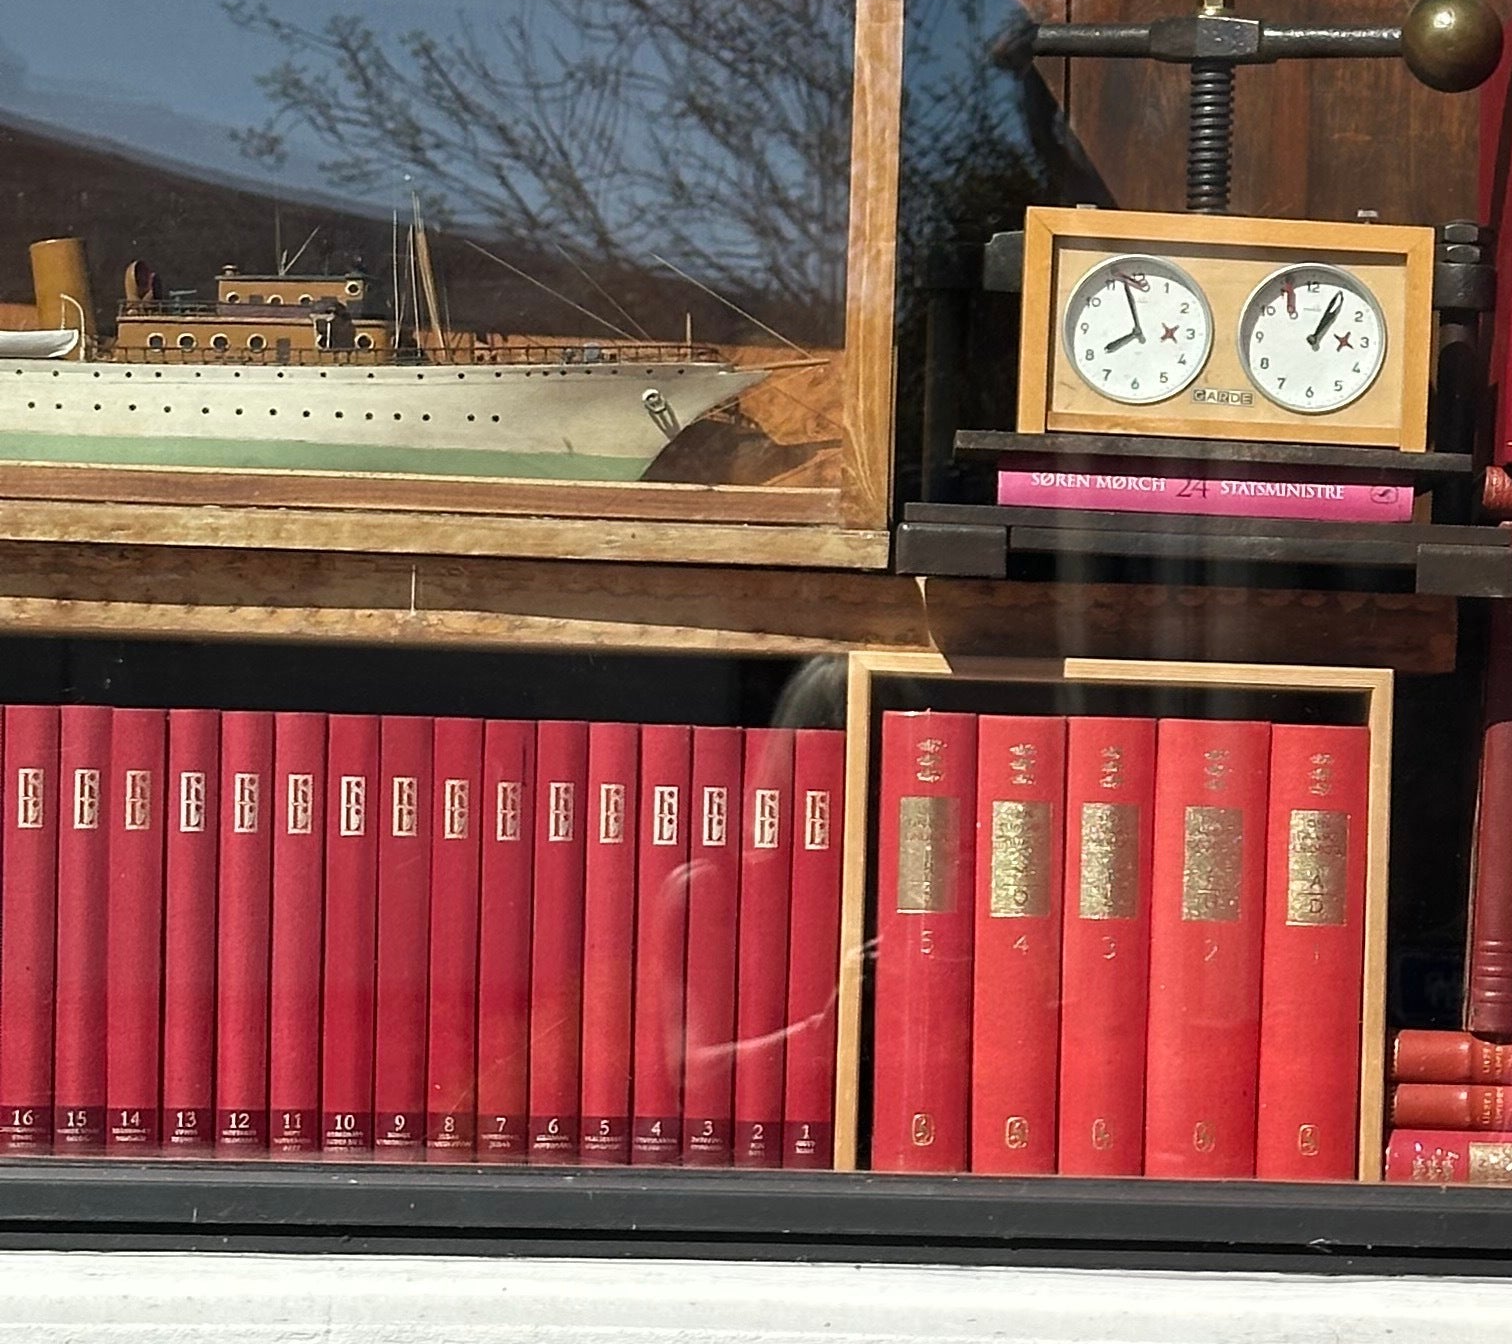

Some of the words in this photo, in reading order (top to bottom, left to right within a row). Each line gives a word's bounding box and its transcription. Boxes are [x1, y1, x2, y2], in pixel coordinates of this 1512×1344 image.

[1105, 279, 1116, 291] 11
[1163, 282, 1170, 294] 1
[1306, 280, 1320, 293] 12
[1086, 296, 1101, 308] 10
[1180, 302, 1190, 314] 2
[1261, 305, 1276, 317] 10
[1354, 311, 1364, 323] 2
[1080, 322, 1090, 335] 9
[1185, 328, 1196, 340] 3
[1255, 331, 1265, 343] 9
[1359, 337, 1370, 349] 3
[1085, 349, 1095, 361] 8
[1177, 353, 1187, 366] 4
[1260, 357, 1270, 370] 8
[1351, 362, 1361, 374] 4
[1102, 369, 1112, 382] 7
[1159, 372, 1169, 384] 5
[1130, 377, 1140, 390] 6
[1277, 377, 1287, 390] 7
[1334, 380, 1344, 392] 5
[1192, 388, 1253, 405] GARDE
[1305, 385, 1315, 399] 6
[1030, 472, 1091, 490] SØREN
[1095, 475, 1167, 493] MØRCH
[1175, 478, 1209, 500] 24
[1219, 479, 1345, 501] STATSMINISTRE
[11, 1109, 34, 1126] 16
[66, 1110, 88, 1127] 15
[120, 1111, 141, 1127] 14
[176, 1111, 197, 1128] 13
[229, 1112, 250, 1129] 12
[282, 1113, 303, 1129] 11
[334, 1113, 355, 1131] 10
[394, 1114, 406, 1132] 9
[443, 1115, 455, 1133] 8
[495, 1116, 507, 1134] 7
[547, 1118, 559, 1135] 6
[598, 1119, 610, 1136] 5
[650, 1120, 662, 1137] 4
[702, 1120, 714, 1137] 3
[752, 1123, 764, 1140] 2
[801, 1124, 811, 1140] 1
